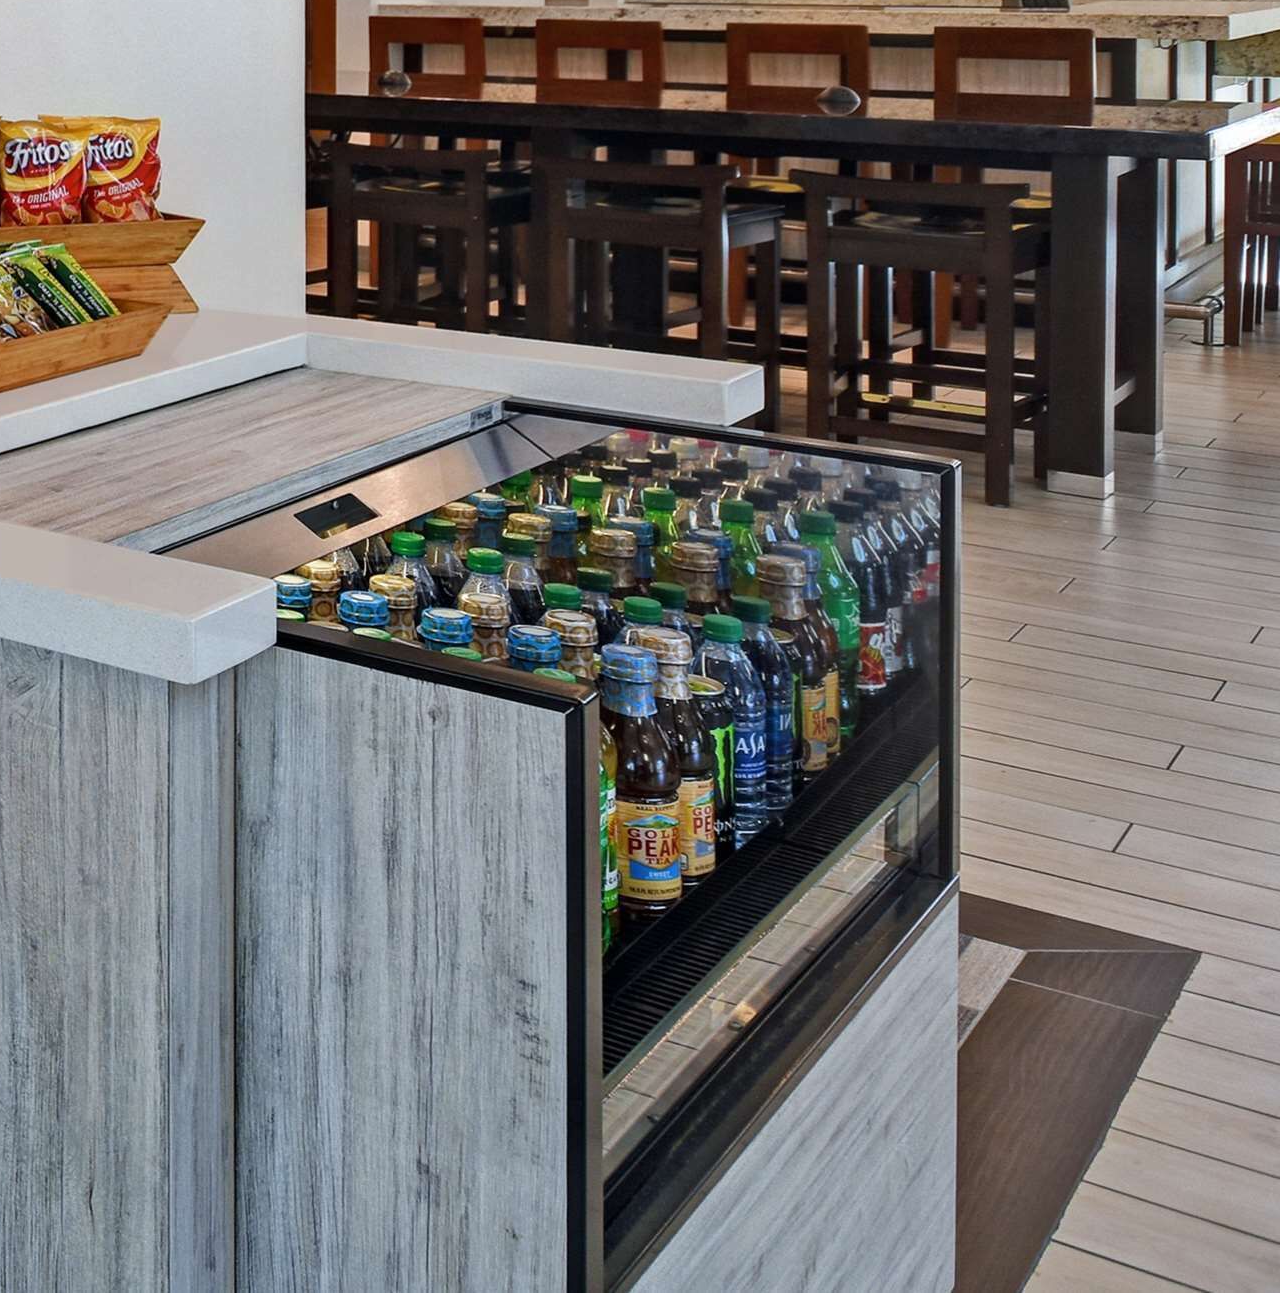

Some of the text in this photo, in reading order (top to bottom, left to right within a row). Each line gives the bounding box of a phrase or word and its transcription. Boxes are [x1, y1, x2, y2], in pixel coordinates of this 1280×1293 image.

[5, 138, 71, 175] Fritos
[27, 185, 70, 204] ORIGINAL
[108, 177, 144, 196] ORIGINAL
[735, 732, 767, 758] ASA
[693, 805, 713, 816] GO
[628, 827, 678, 838] GOLD
[693, 815, 714, 834] PE
[628, 838, 680, 857] PEAK
[645, 857, 673, 865] TEA
